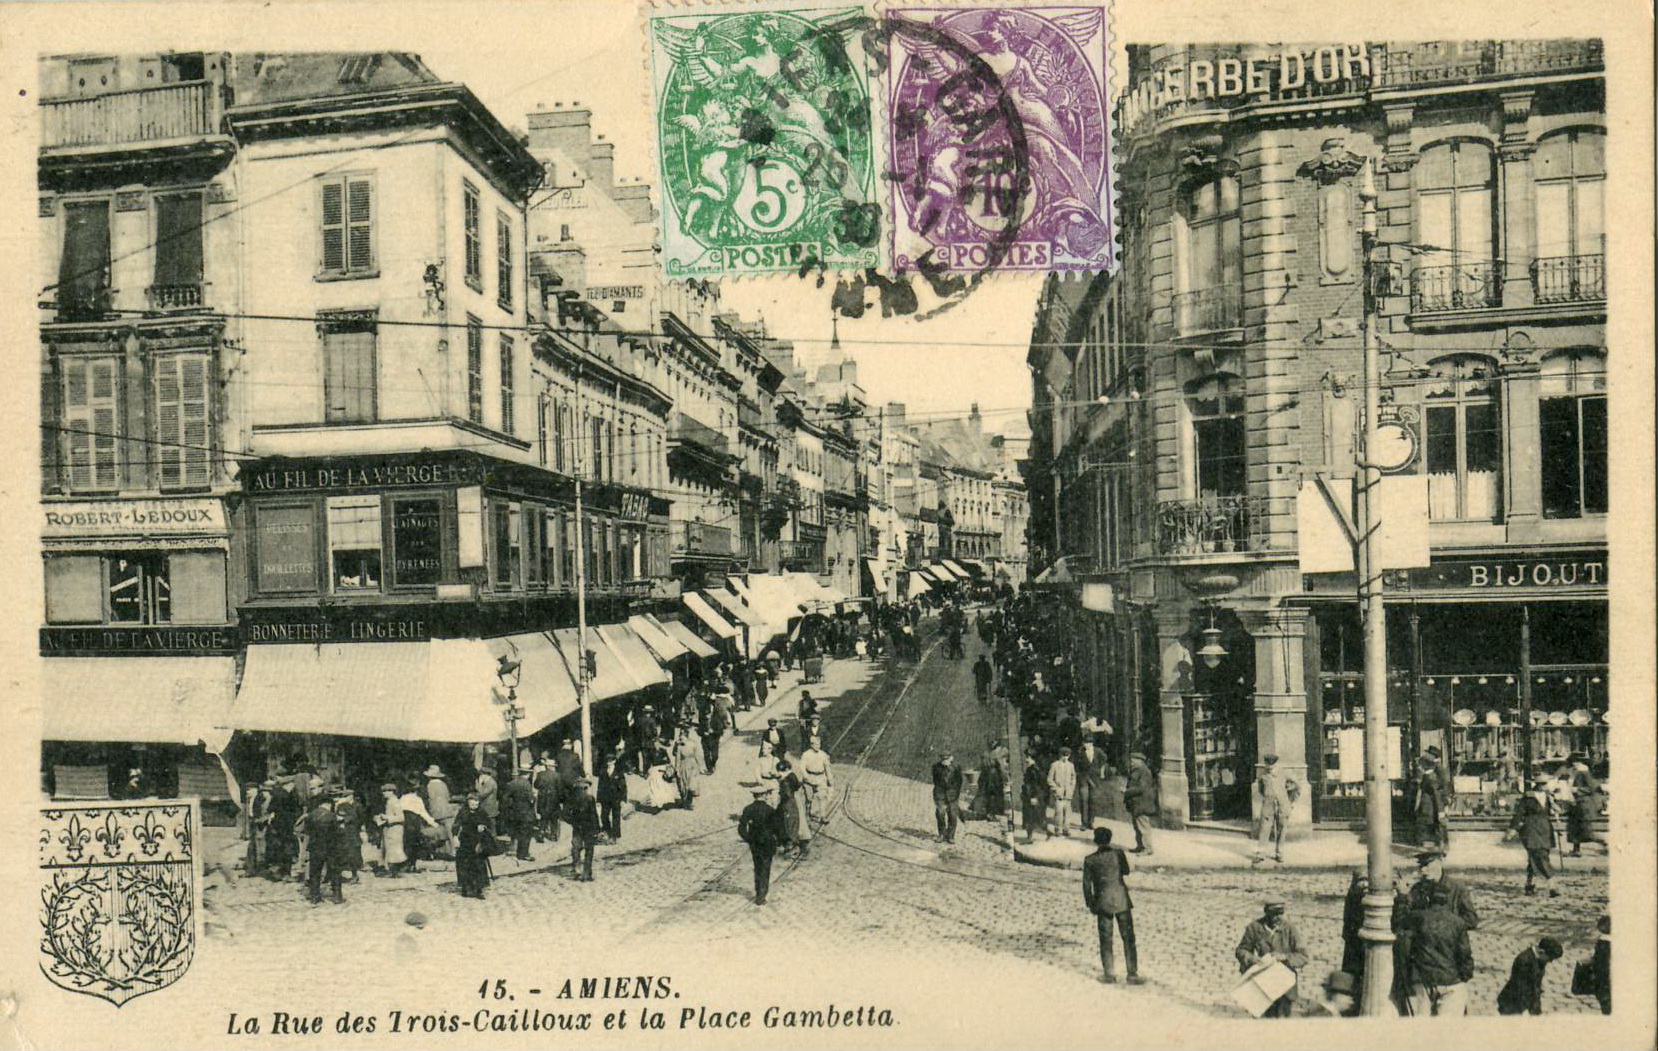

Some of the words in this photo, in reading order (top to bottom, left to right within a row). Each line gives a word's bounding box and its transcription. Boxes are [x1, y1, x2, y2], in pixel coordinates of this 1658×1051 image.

[1279, 41, 1370, 90] D'OR
[727, 244, 819, 268] POSTES
[953, 244, 1048, 267] POTES
[255, 473, 277, 490] AU
[285, 470, 312, 488] FIL
[319, 469, 341, 487] DE
[348, 468, 369, 486] LA
[374, 464, 443, 484] VIERGE
[103, 631, 127, 648] DE
[155, 630, 222, 649] VIERGE
[253, 624, 332, 641] BONNETERIE
[351, 621, 425, 639] LINGERIE
